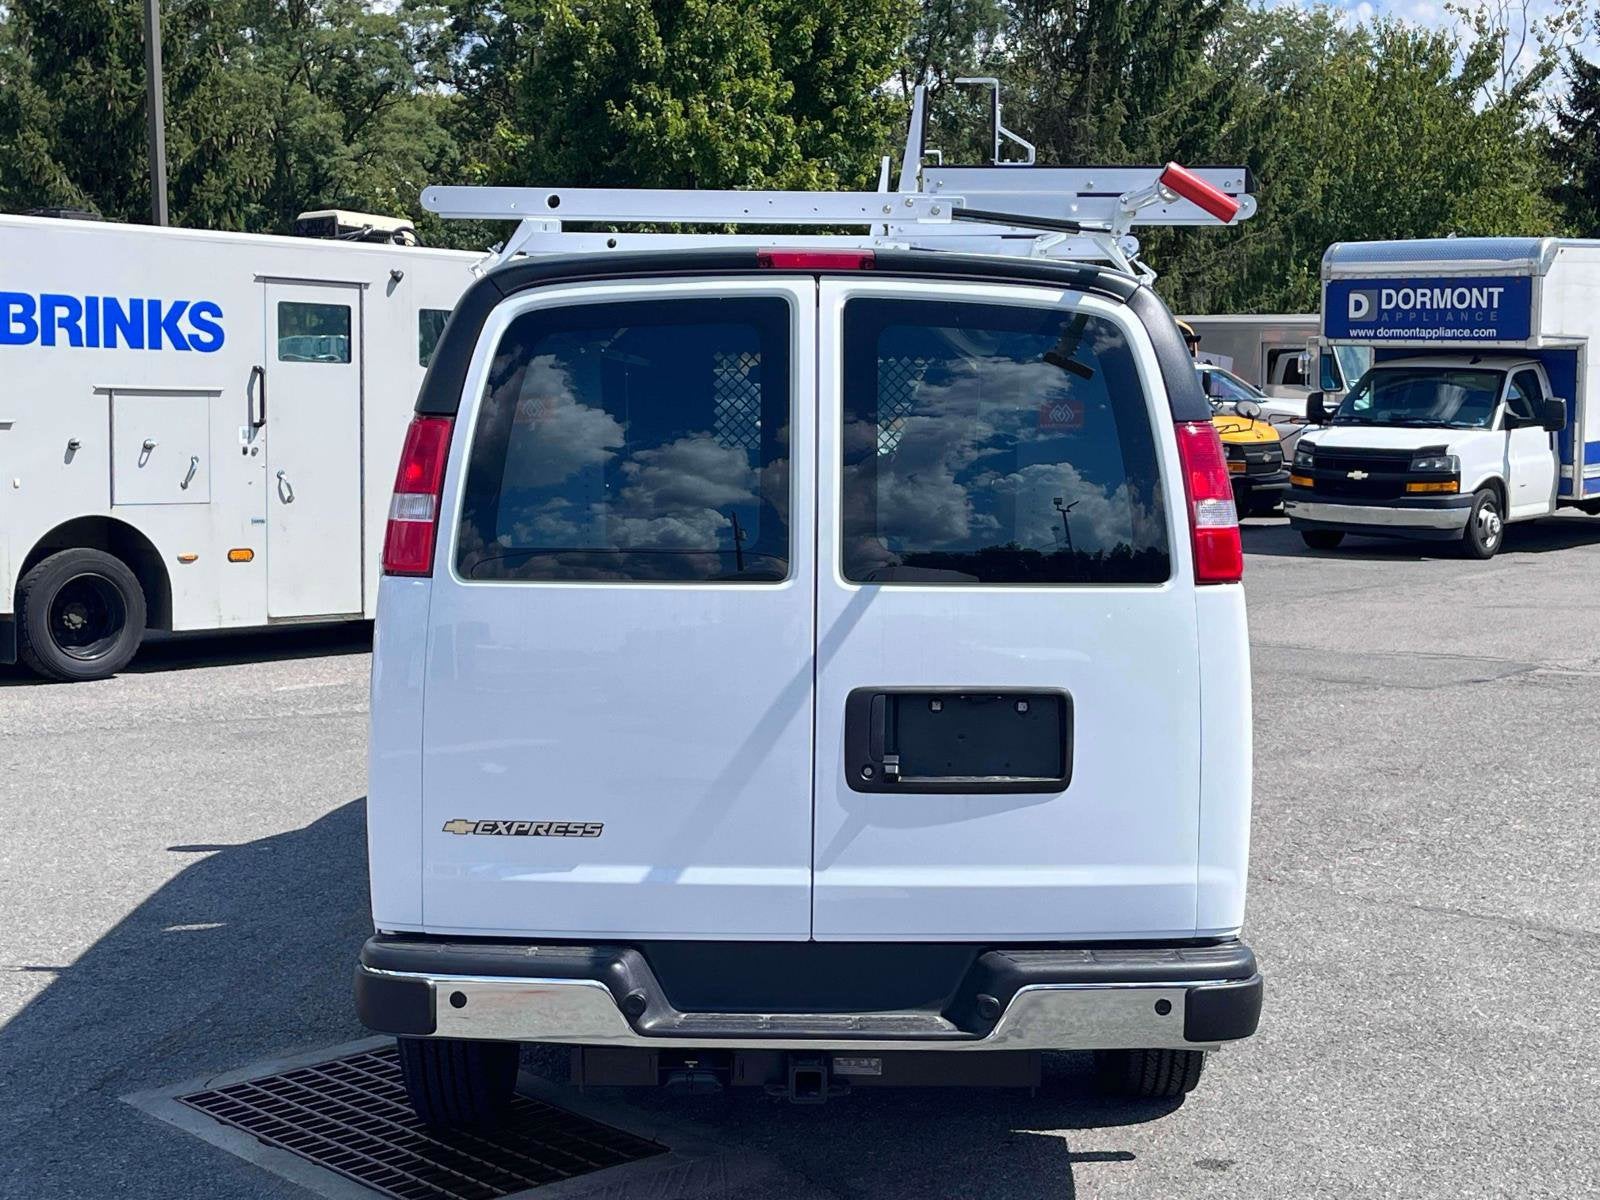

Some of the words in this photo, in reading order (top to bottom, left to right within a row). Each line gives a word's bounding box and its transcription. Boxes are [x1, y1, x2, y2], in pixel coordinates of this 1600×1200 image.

[1348, 293, 1370, 319] D
[1381, 287, 1504, 310] DORMONT
[0, 291, 225, 352] BRINKS
[1381, 311, 1497, 322] APPLIANCE
[475, 821, 603, 837] EXPRESS
